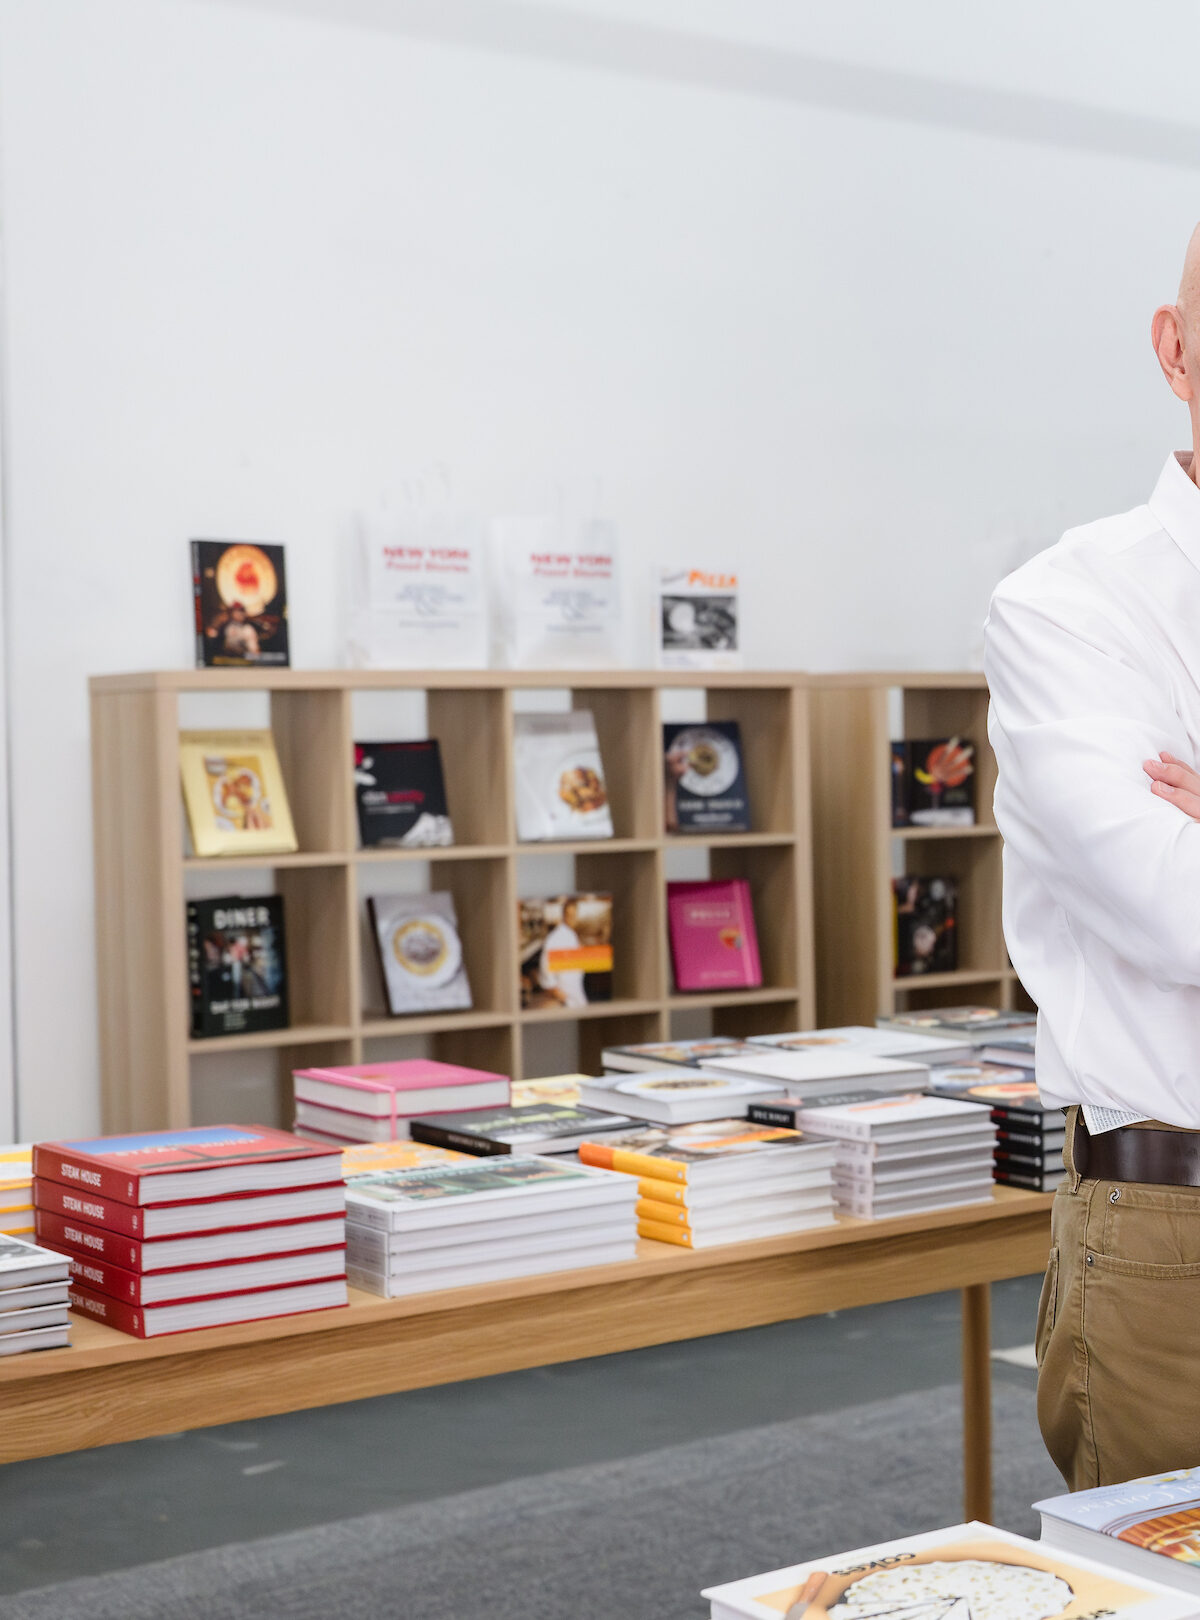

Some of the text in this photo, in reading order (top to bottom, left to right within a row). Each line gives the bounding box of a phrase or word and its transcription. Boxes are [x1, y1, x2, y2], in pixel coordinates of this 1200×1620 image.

[383, 545, 469, 560] NEW YORK
[530, 552, 571, 565] NEW
[213, 906, 271, 930] DINER
[61, 1163, 102, 1188] STEAK HOUSE
[63, 1195, 105, 1220] STEAK HOUSE
[64, 1226, 105, 1252] STEAK HOUSE
[83, 1265, 105, 1285] HOUSE
[84, 1297, 107, 1317] HOUSE
